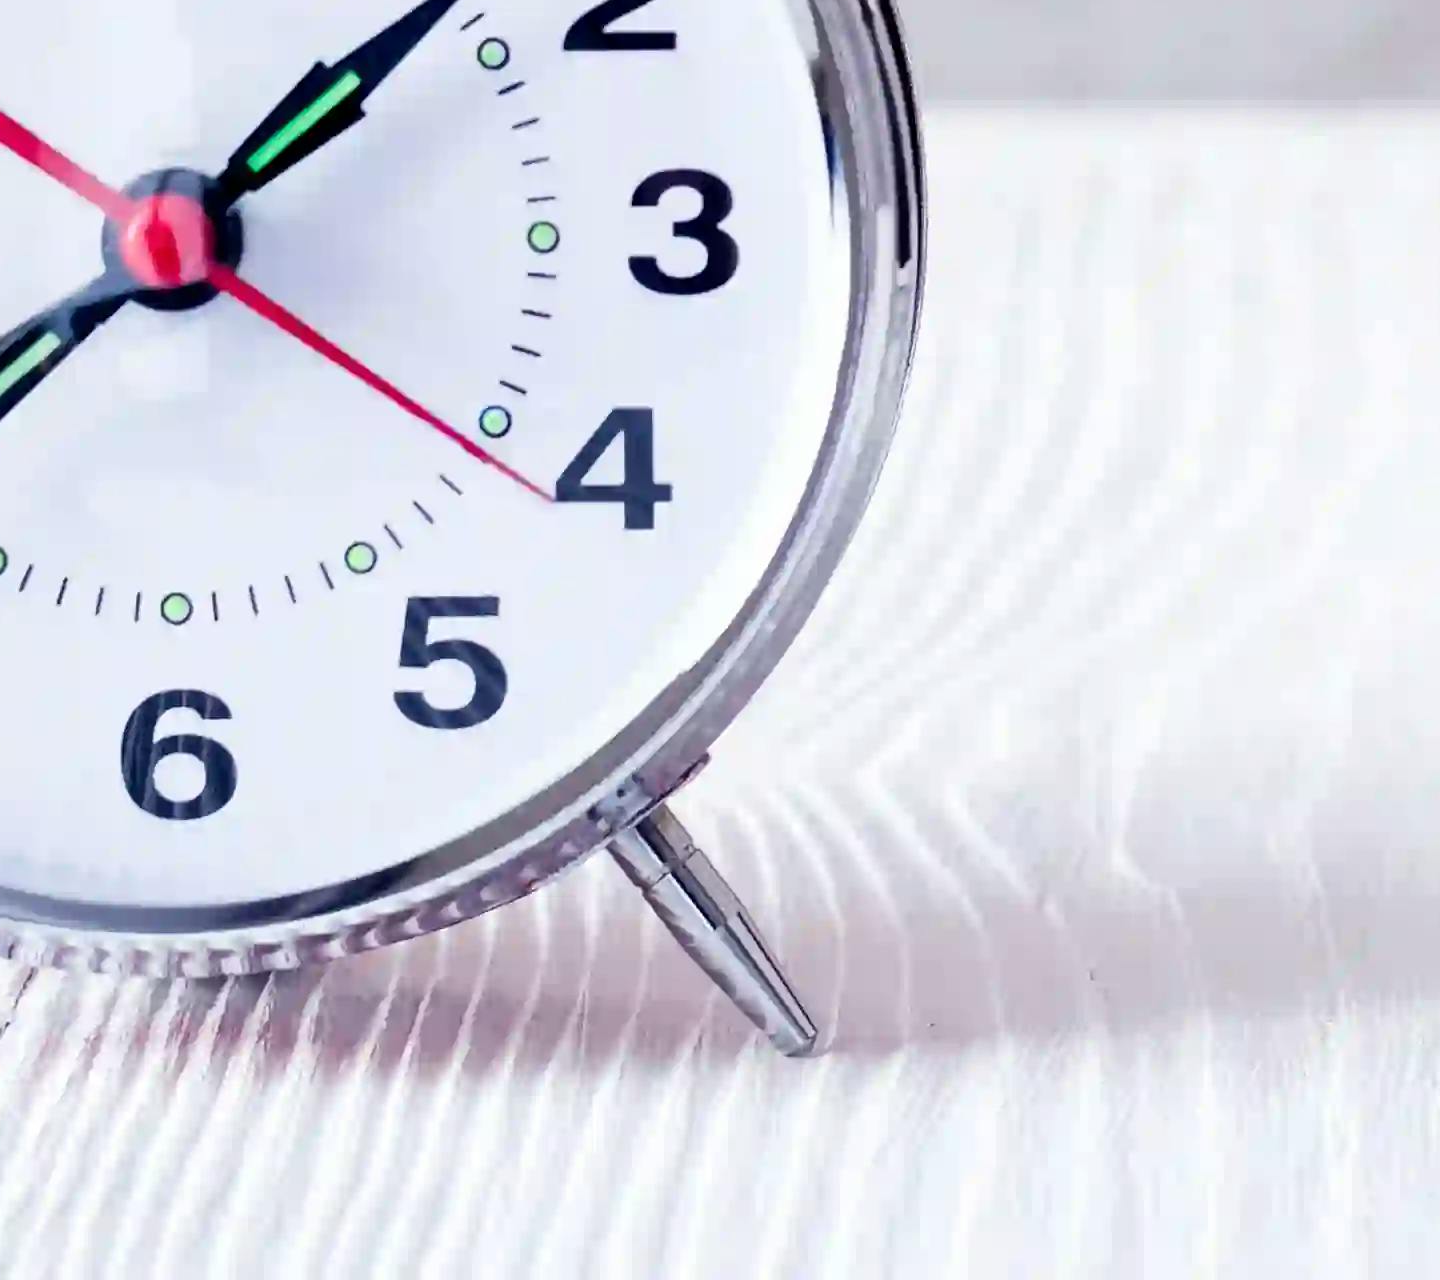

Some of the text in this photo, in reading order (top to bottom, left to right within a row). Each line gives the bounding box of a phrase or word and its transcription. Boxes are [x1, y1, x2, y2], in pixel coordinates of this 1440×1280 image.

[626, 167, 740, 297] 3
[554, 406, 674, 531] 4
[392, 594, 509, 731] 5
[119, 688, 238, 822] 6
